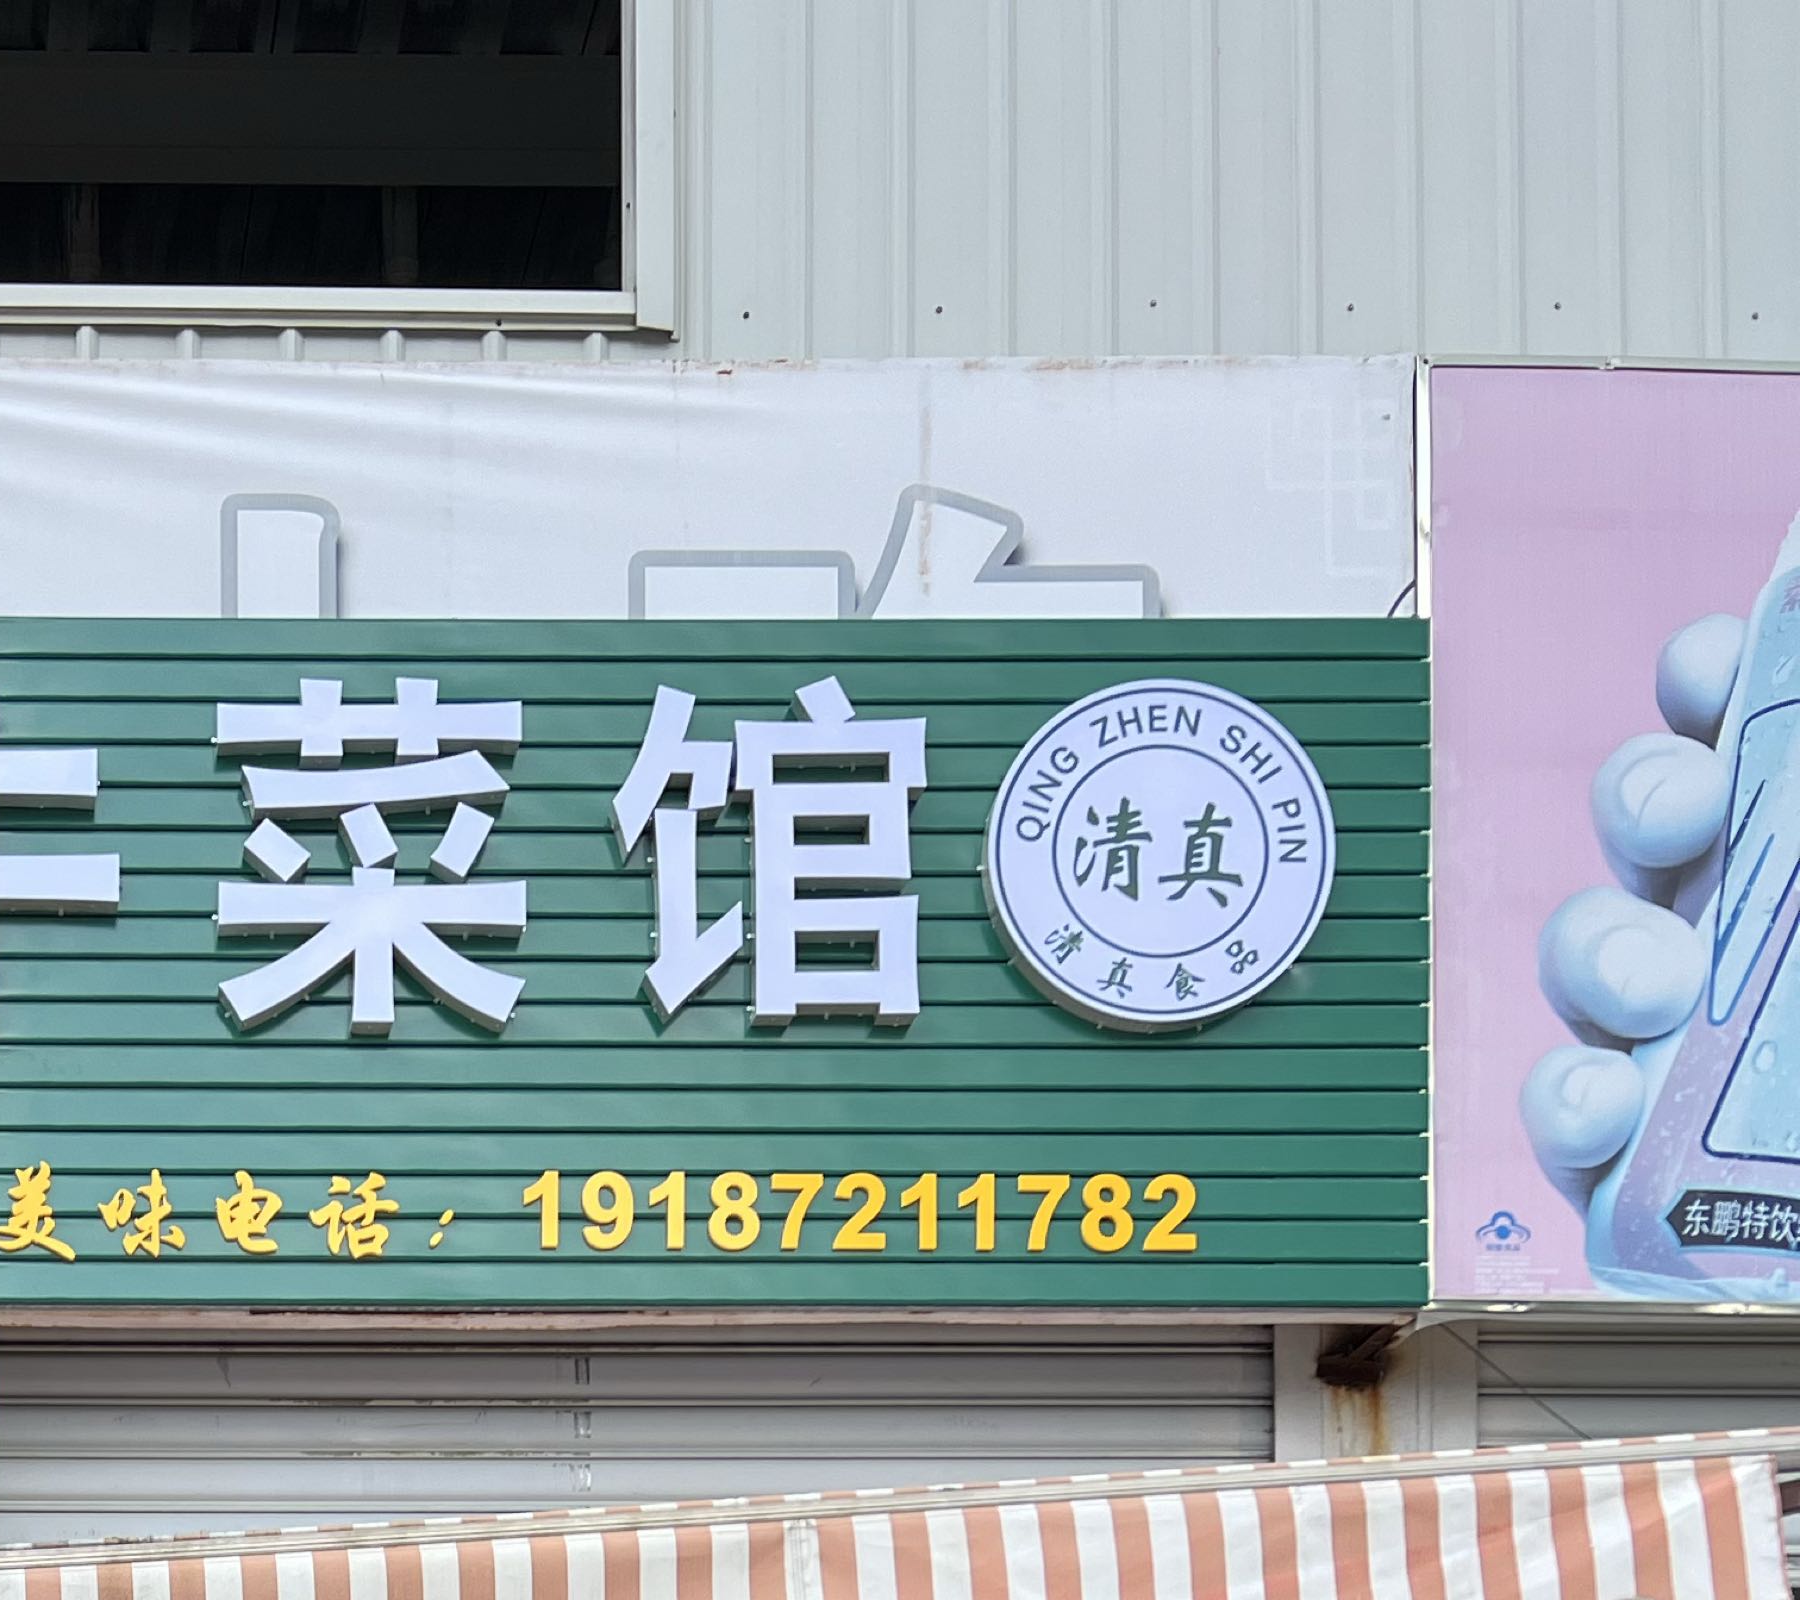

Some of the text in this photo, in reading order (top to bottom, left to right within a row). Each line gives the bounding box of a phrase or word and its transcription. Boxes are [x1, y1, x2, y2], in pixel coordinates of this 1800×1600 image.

[1015, 703, 1307, 864] QING ZHEN SHI PIN
[1073, 796, 1244, 908] 清真
[1044, 923, 1258, 1000] 清真食品
[521, 1169, 1198, 1253] 19187211782
[1681, 1198, 1800, 1249] 东鹏特饮
